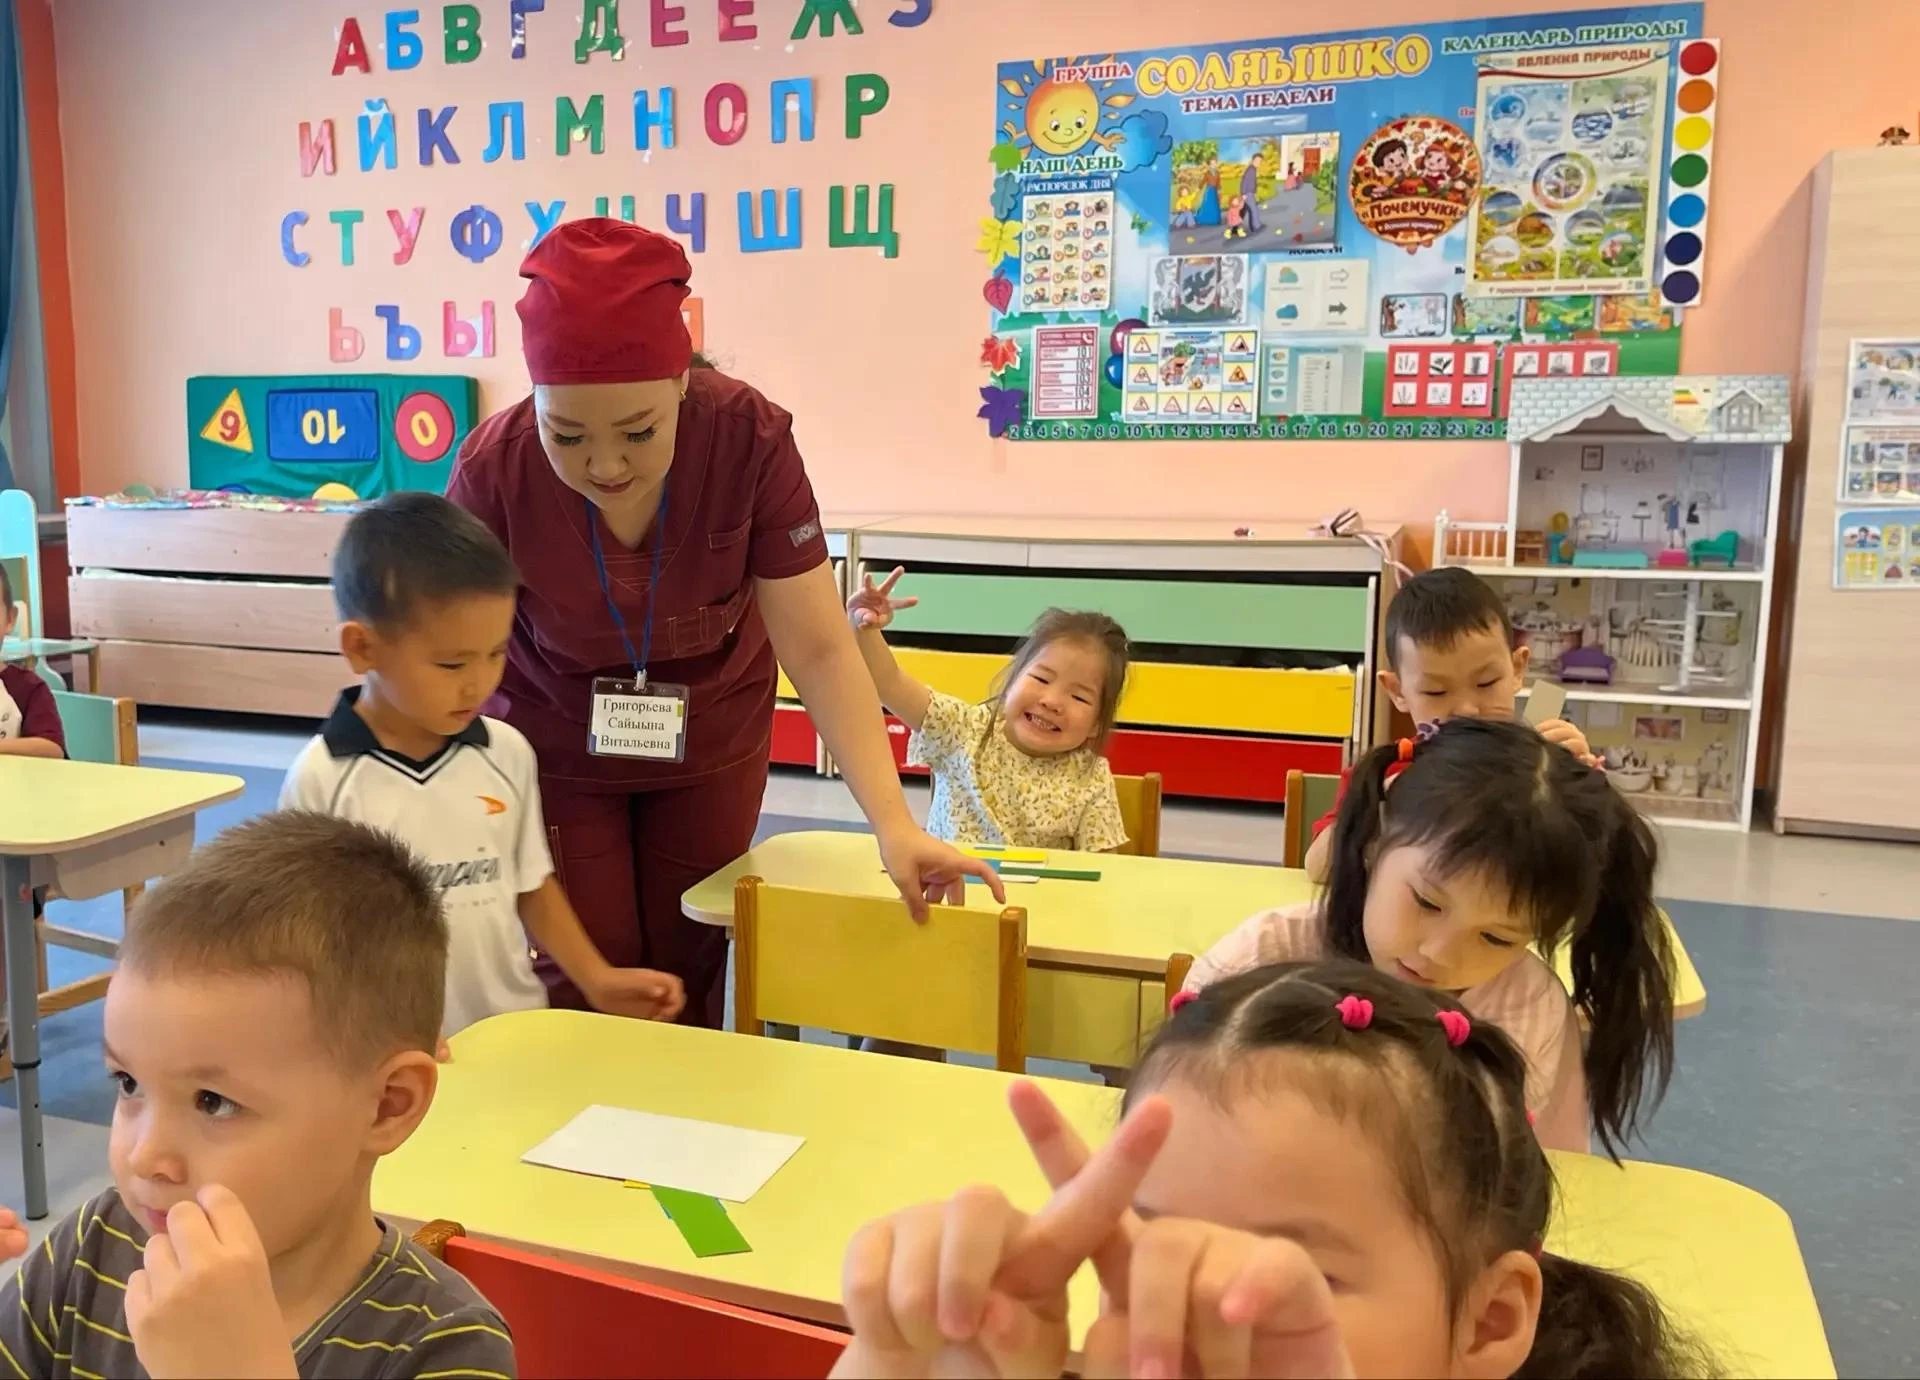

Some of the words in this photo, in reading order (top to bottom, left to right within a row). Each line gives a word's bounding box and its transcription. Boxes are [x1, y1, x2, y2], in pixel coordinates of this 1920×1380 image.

[332, 17, 371, 76] А
[386, 10, 423, 71] Б
[444, 4, 482, 64] В
[511, 0, 544, 60] Г
[574, 0, 625, 64] Д
[1443, 32, 1573, 53] КАЛЕНДАРЬ
[1579, 20, 1687, 41] ПРИРОДЫ
[1054, 63, 1132, 83] ГРУППА
[1138, 35, 1431, 96] СОЛНЫШКО
[1517, 52, 1580, 68] ЯВЛЕНИЯ
[1583, 49, 1651, 64] ПРИРОДЫ
[1181, 93, 1240, 113] ТЕМА
[1245, 87, 1335, 110] НЕДЕЛИ
[299, 119, 338, 178] И
[357, 97, 398, 172] Й
[417, 106, 461, 166] К
[482, 102, 525, 163] Л
[556, 95, 605, 156] М
[634, 87, 676, 151] Н
[704, 82, 748, 146] О
[770, 77, 815, 144] П
[845, 73, 890, 139] Р
[1019, 158, 1066, 174] НАШ
[1071, 155, 1124, 173] ДЕНЬ
[281, 210, 311, 267] С
[329, 210, 364, 266] Т
[387, 207, 425, 266] У
[450, 204, 503, 263] Ф
[665, 193, 706, 253] Ч
[737, 187, 803, 253] Ш
[828, 184, 900, 259] Щ
[329, 307, 364, 363] Ь
[375, 305, 422, 361] Ъ
[443, 300, 496, 358] Ы
[1010, 424, 1019, 437] 2
[1024, 424, 1033, 437] 3
[1037, 424, 1047, 437] 4
[1052, 424, 1061, 437] 5
[1065, 424, 1075, 437] 6
[1080, 424, 1089, 437] 7
[1095, 424, 1104, 437] 8
[1109, 424, 1119, 437] 9
[1126, 424, 1141, 437] 10
[1150, 424, 1164, 437] 11
[1173, 424, 1189, 437] 12
[1197, 424, 1212, 437] 13
[1221, 424, 1237, 437] 14
[1245, 423, 1261, 437] 15
[1270, 423, 1286, 437] 16
[1294, 423, 1311, 437] 17
[1320, 423, 1336, 437] 18
[1344, 423, 1361, 437] 19
[1369, 423, 1387, 437] 20
[1395, 423, 1412, 437] 21
[1420, 423, 1439, 437] 22
[1449, 423, 1466, 437] 23
[1475, 423, 1493, 437] 24
[603, 698, 672, 714] Григорьева
[608, 717, 665, 731] Сайыына
[601, 735, 671, 750] Витальевна
